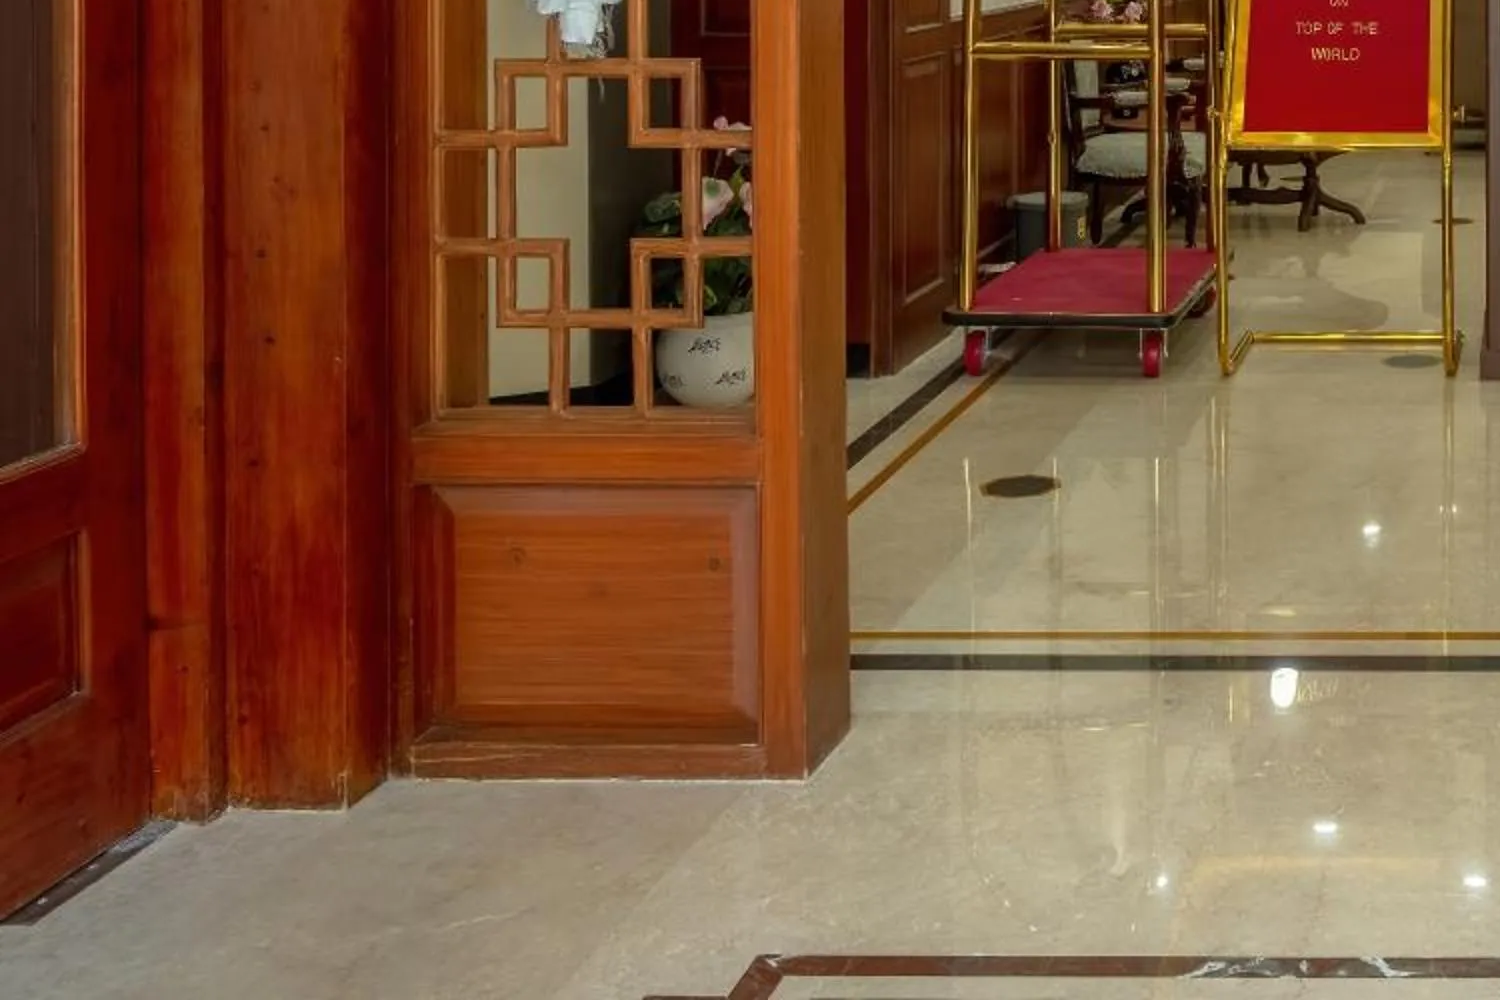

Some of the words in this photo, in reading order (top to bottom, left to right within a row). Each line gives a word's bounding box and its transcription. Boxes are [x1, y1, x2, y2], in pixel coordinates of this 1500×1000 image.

[1295, 21, 1322, 35] TOP
[1327, 21, 1344, 35] OF
[1352, 21, 1377, 35] THE
[1311, 47, 1361, 61] WORLD
